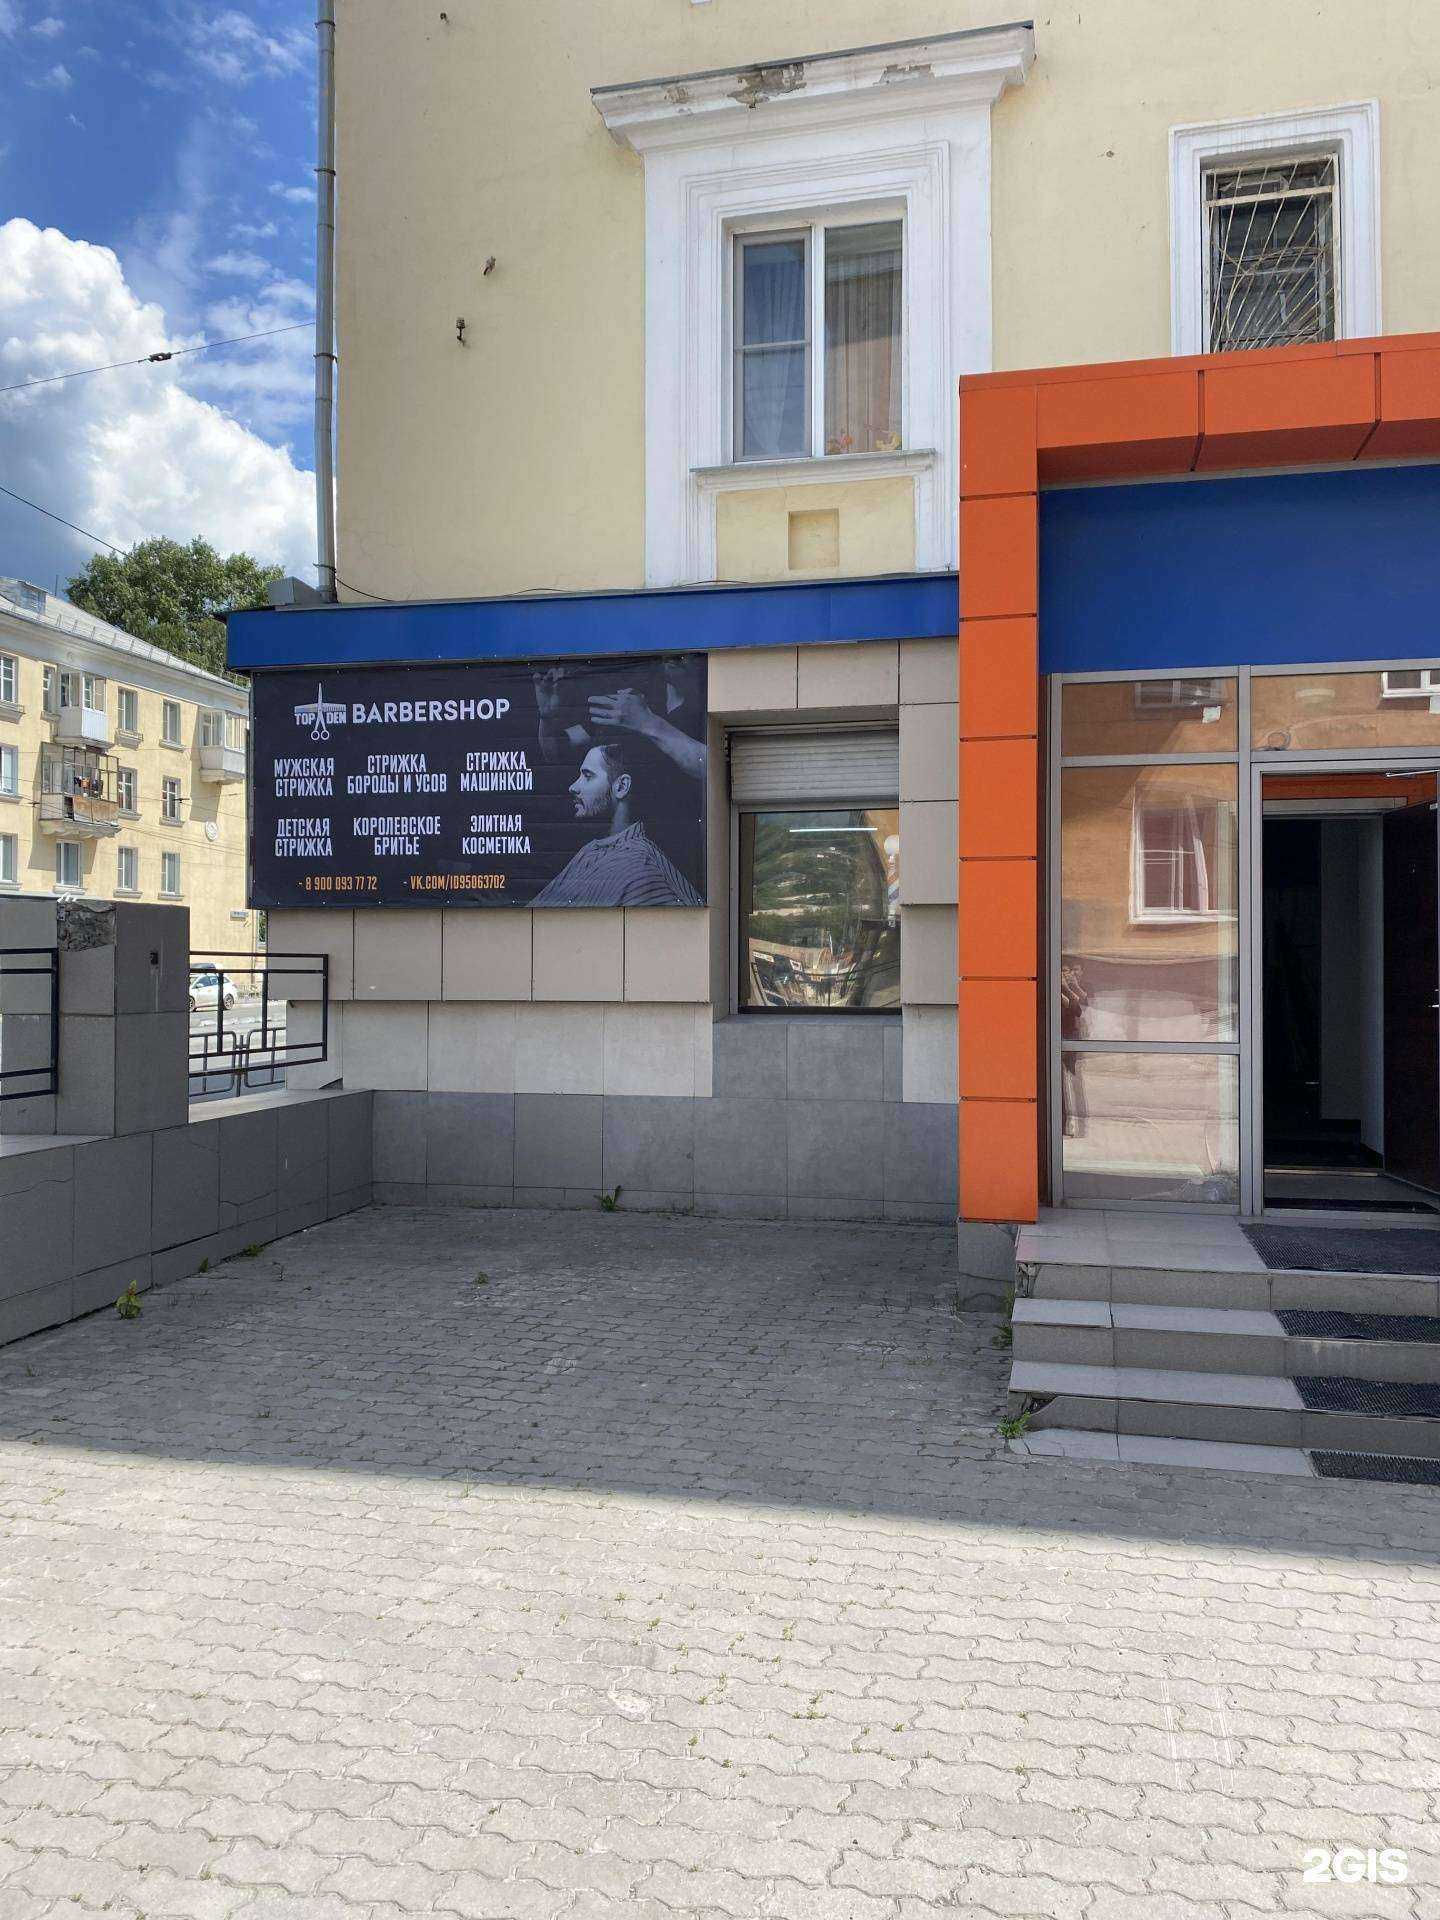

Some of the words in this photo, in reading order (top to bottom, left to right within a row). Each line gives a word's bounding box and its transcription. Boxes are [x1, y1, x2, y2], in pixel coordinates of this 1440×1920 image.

[294, 713, 316, 726] TOP
[352, 698, 510, 724] BARBERSHOP
[274, 757, 335, 778] МУЖСКАЯ
[367, 753, 426, 774] СТРИЖКА
[466, 751, 527, 771] СТРИЖКА
[275, 777, 333, 797] СТРИЖКА
[347, 775, 399, 794] БОРОДЫ
[403, 775, 412, 793] И
[416, 773, 447, 792] УСОВ
[460, 768, 533, 792] МАШИНКОЙ
[276, 818, 330, 837] ДЕТСКАЯ
[353, 815, 441, 836] КОРОЛЕВСКОЕ
[470, 814, 522, 832] ЭЛИТНАЯ
[275, 837, 333, 857] СТРИЖКА
[374, 837, 420, 856] БРИТЬЕ
[462, 836, 531, 854] КОСМЕТИКА
[305, 876, 312, 891] 8
[314, 876, 332, 890] 900
[335, 876, 353, 890] 093
[355, 876, 365, 890] 77
[367, 876, 377, 890] 72
